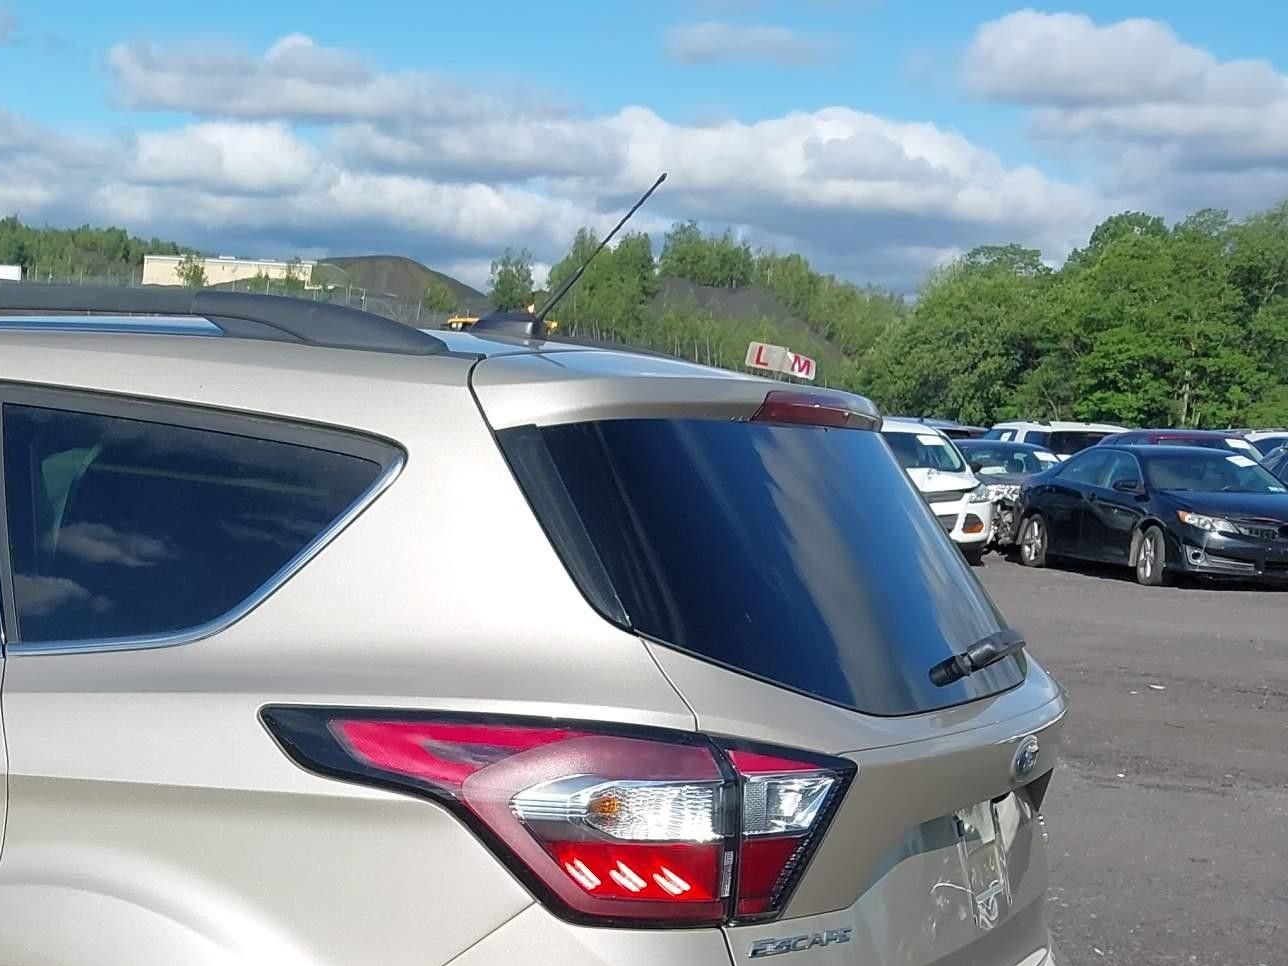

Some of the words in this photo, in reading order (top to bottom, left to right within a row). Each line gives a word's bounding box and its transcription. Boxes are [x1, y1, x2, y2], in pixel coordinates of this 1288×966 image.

[755, 345, 769, 367] L
[790, 354, 811, 376] M
[747, 927, 852, 958] ESCAPE
